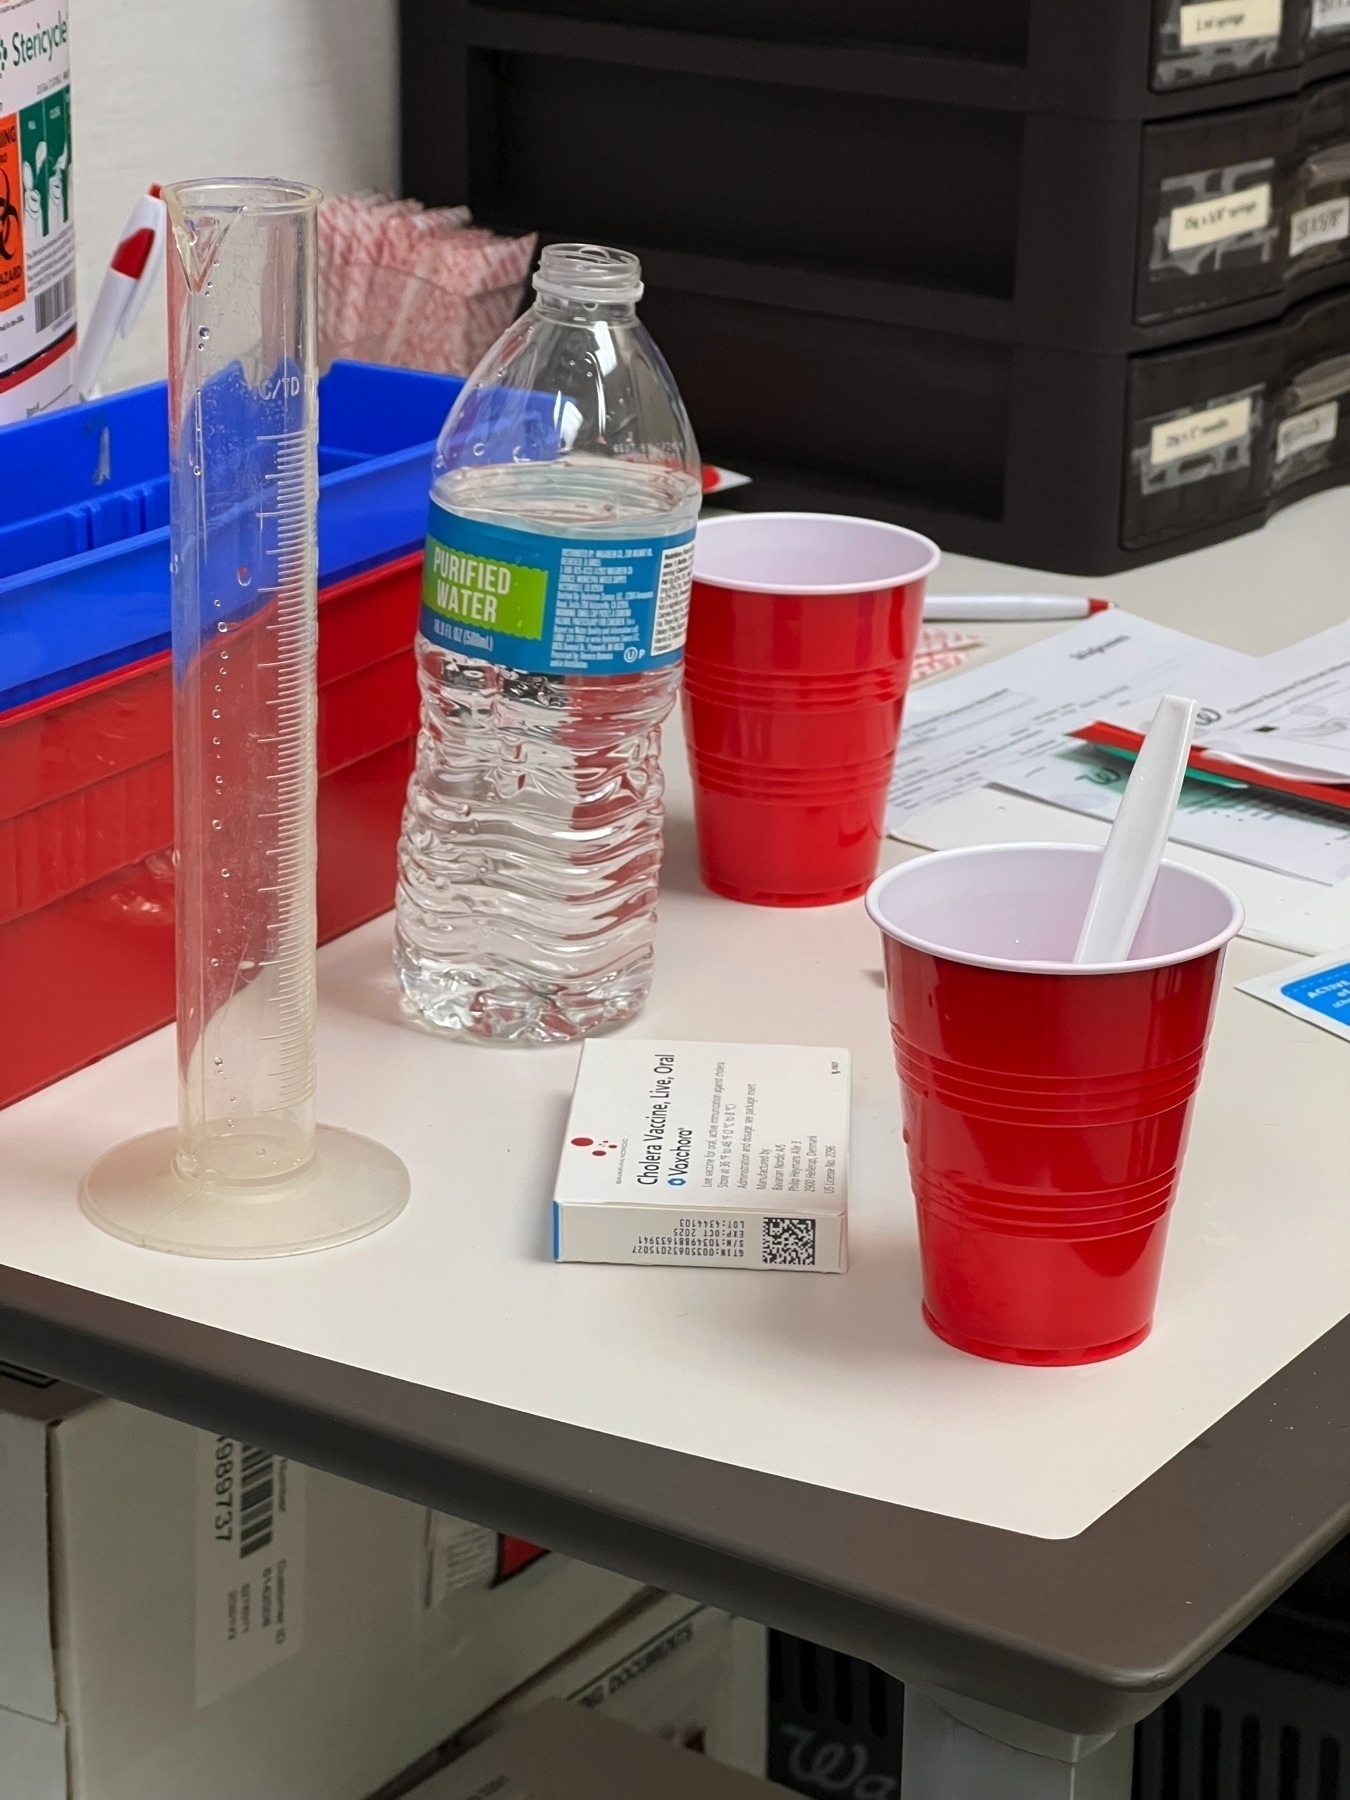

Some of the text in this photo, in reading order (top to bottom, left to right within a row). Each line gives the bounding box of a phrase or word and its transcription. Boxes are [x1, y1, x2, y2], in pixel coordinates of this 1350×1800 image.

[12, 10, 67, 66] Stericycle
[433, 546, 511, 595] PURIFIED
[437, 579, 498, 623] WATER
[745, 1097, 757, 1115] package
[636, 1054, 675, 1185] Cholera Vaccine, Live, Oral
[740, 1143, 751, 1152] and
[806, 1136, 817, 1156] Denmark
[704, 1159, 714, 1176] vaccine
[774, 1153, 785, 1168] Nordic
[790, 1156, 803, 1177] Heymans
[737, 1153, 750, 1189] Administration
[756, 1156, 769, 1189] Manufactured
[772, 1170, 783, 1190] Bavarian
[824, 1168, 835, 1185] License
[718, 1175, 729, 1188] Store
[673, 1228, 744, 1238] EXP:OCT 2025
[679, 1219, 744, 1229] LOT:4344103
[632, 1245, 744, 1257] GTIN:00350632015027
